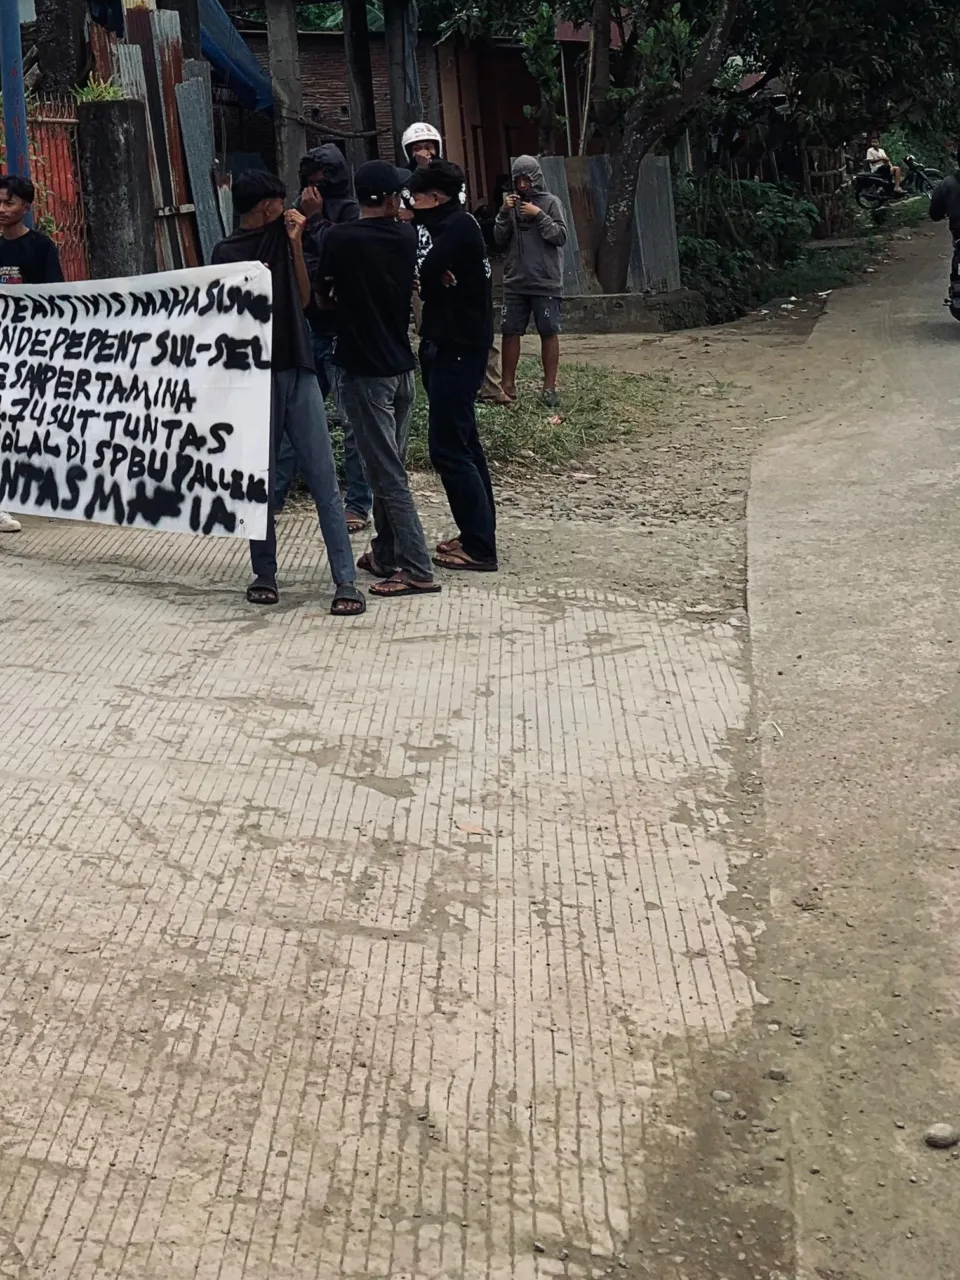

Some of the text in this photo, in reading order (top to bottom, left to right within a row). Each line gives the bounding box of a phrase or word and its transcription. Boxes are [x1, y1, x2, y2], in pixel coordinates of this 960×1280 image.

[150, 329, 271, 371] SUL-SEL
[103, 410, 234, 455] TUNTAS
[66, 435, 87, 466] DI
[92, 439, 168, 483] SPBU
